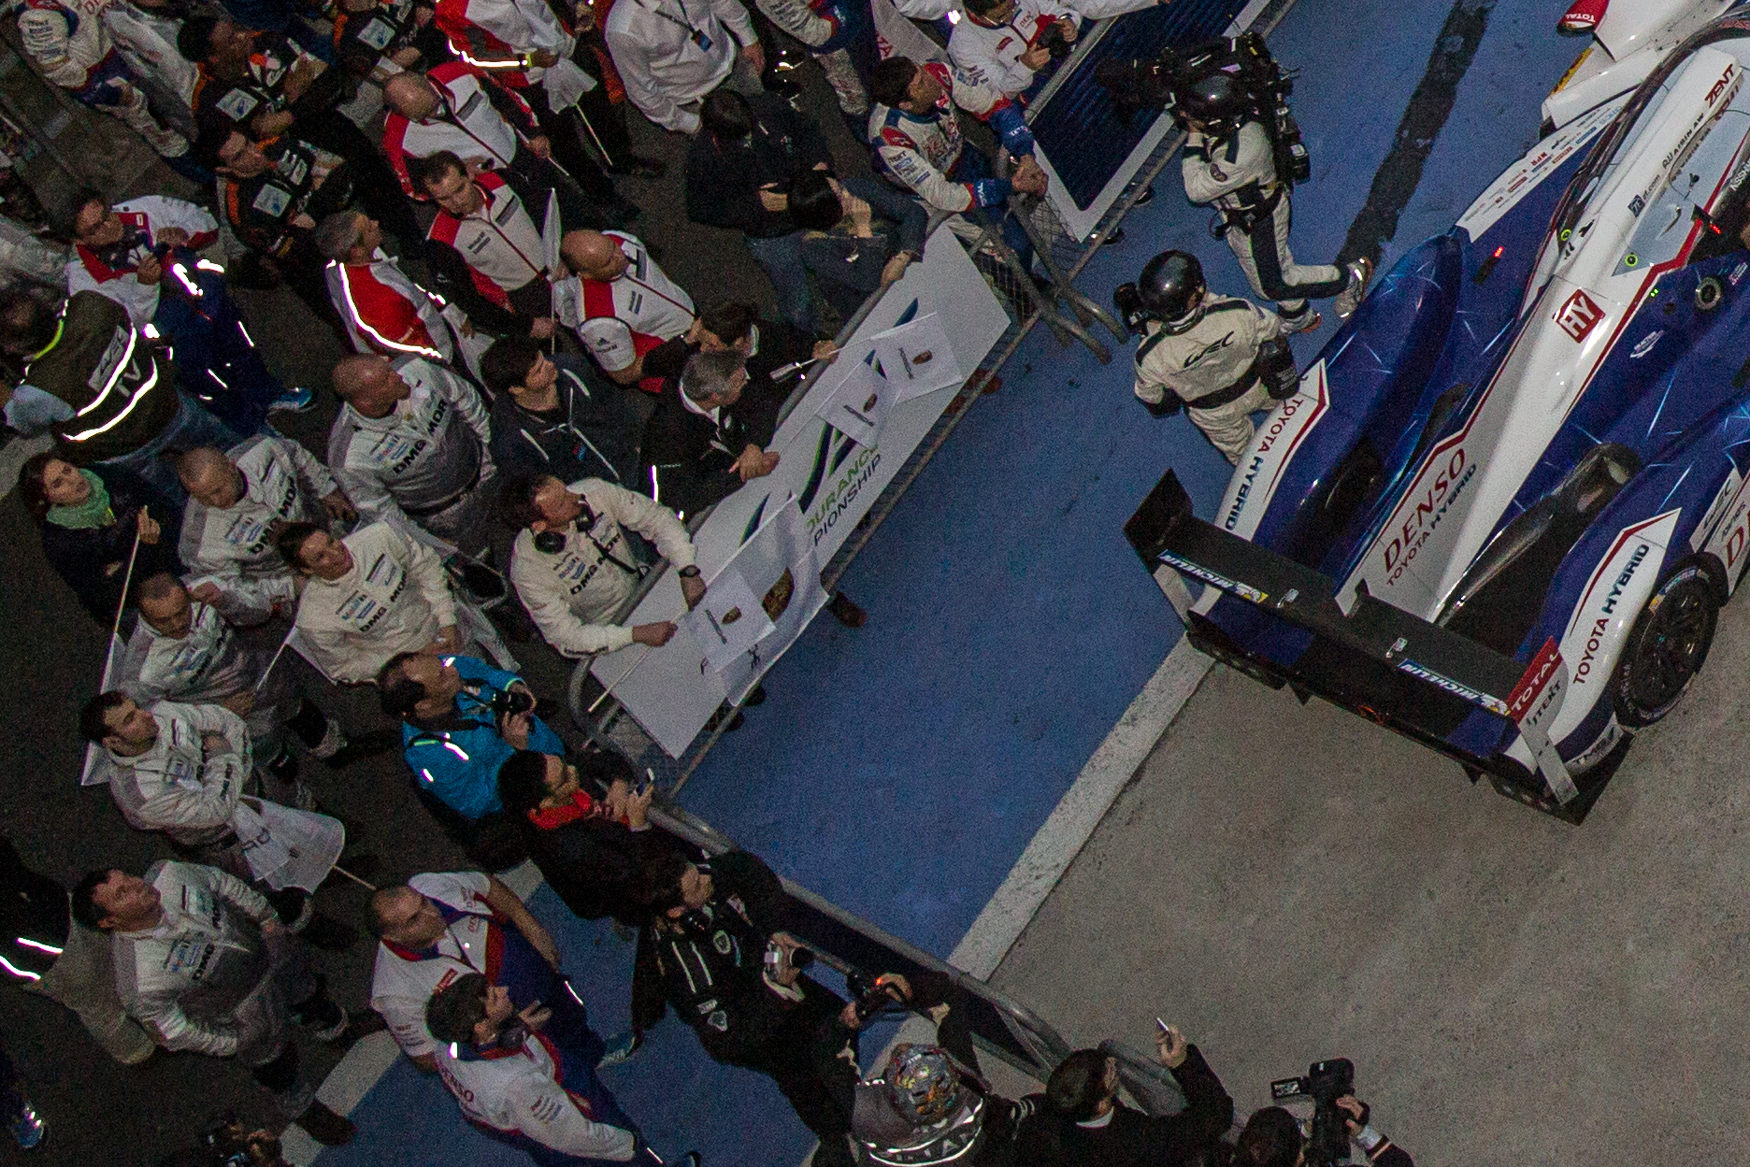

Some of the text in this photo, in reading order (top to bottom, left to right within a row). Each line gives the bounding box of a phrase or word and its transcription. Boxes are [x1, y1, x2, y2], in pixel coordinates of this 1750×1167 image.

[1565, 13, 1596, 22] TOTAL
[1704, 64, 1737, 109] ZENT
[1560, 296, 1594, 338] HY
[1184, 331, 1234, 368] WEC
[392, 399, 449, 475] DMG MOR
[1225, 398, 1304, 531] TOYOTA HYBRID
[813, 453, 882, 547] PIONSHIP
[1383, 448, 1466, 574] DENSO
[1386, 463, 1477, 587] TOYOTA HYBRID
[570, 564, 598, 595] DMG
[1161, 554, 1235, 589] MICHELIN
[358, 606, 388, 634] DMG
[1573, 543, 1650, 685] TOYOTA HYBRID
[1400, 662, 1483, 700] MICHELIN
[1511, 650, 1559, 711] TOTAL
